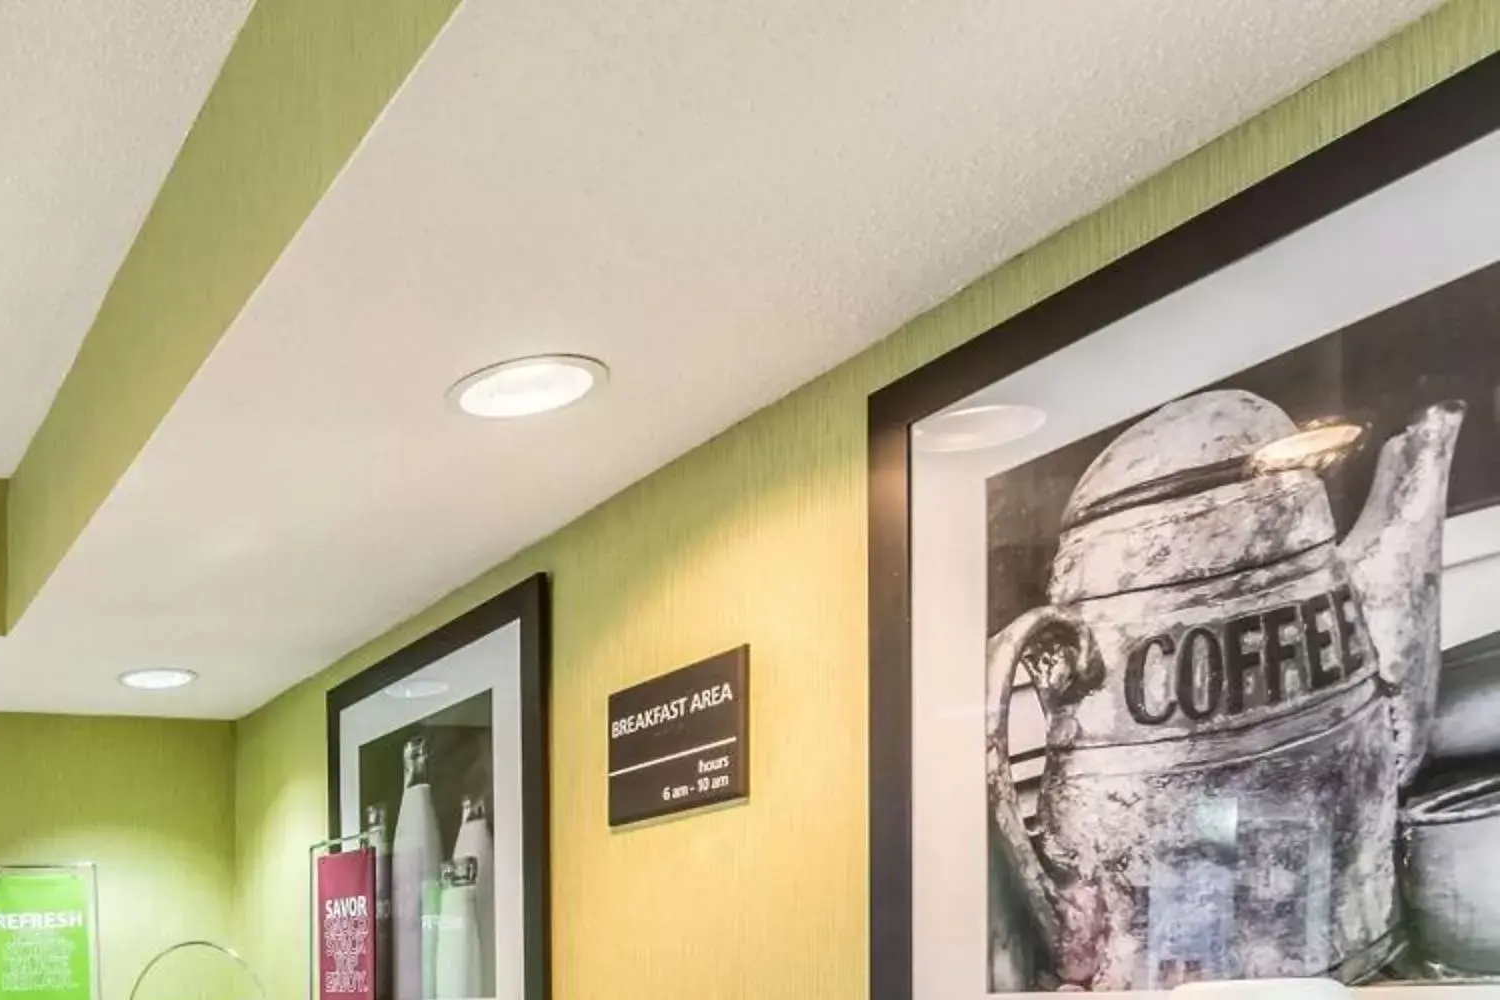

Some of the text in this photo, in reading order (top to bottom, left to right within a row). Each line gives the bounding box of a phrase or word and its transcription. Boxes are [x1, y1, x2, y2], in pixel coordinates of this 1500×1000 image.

[1124, 583, 1364, 725] COFFEE
[612, 683, 732, 739] BREAKFAST AREA
[699, 756, 729, 773] hours
[663, 786, 670, 800] 6
[672, 785, 688, 798] am
[697, 778, 709, 792] 10
[712, 775, 729, 789] am
[325, 895, 367, 918] SAVOR
